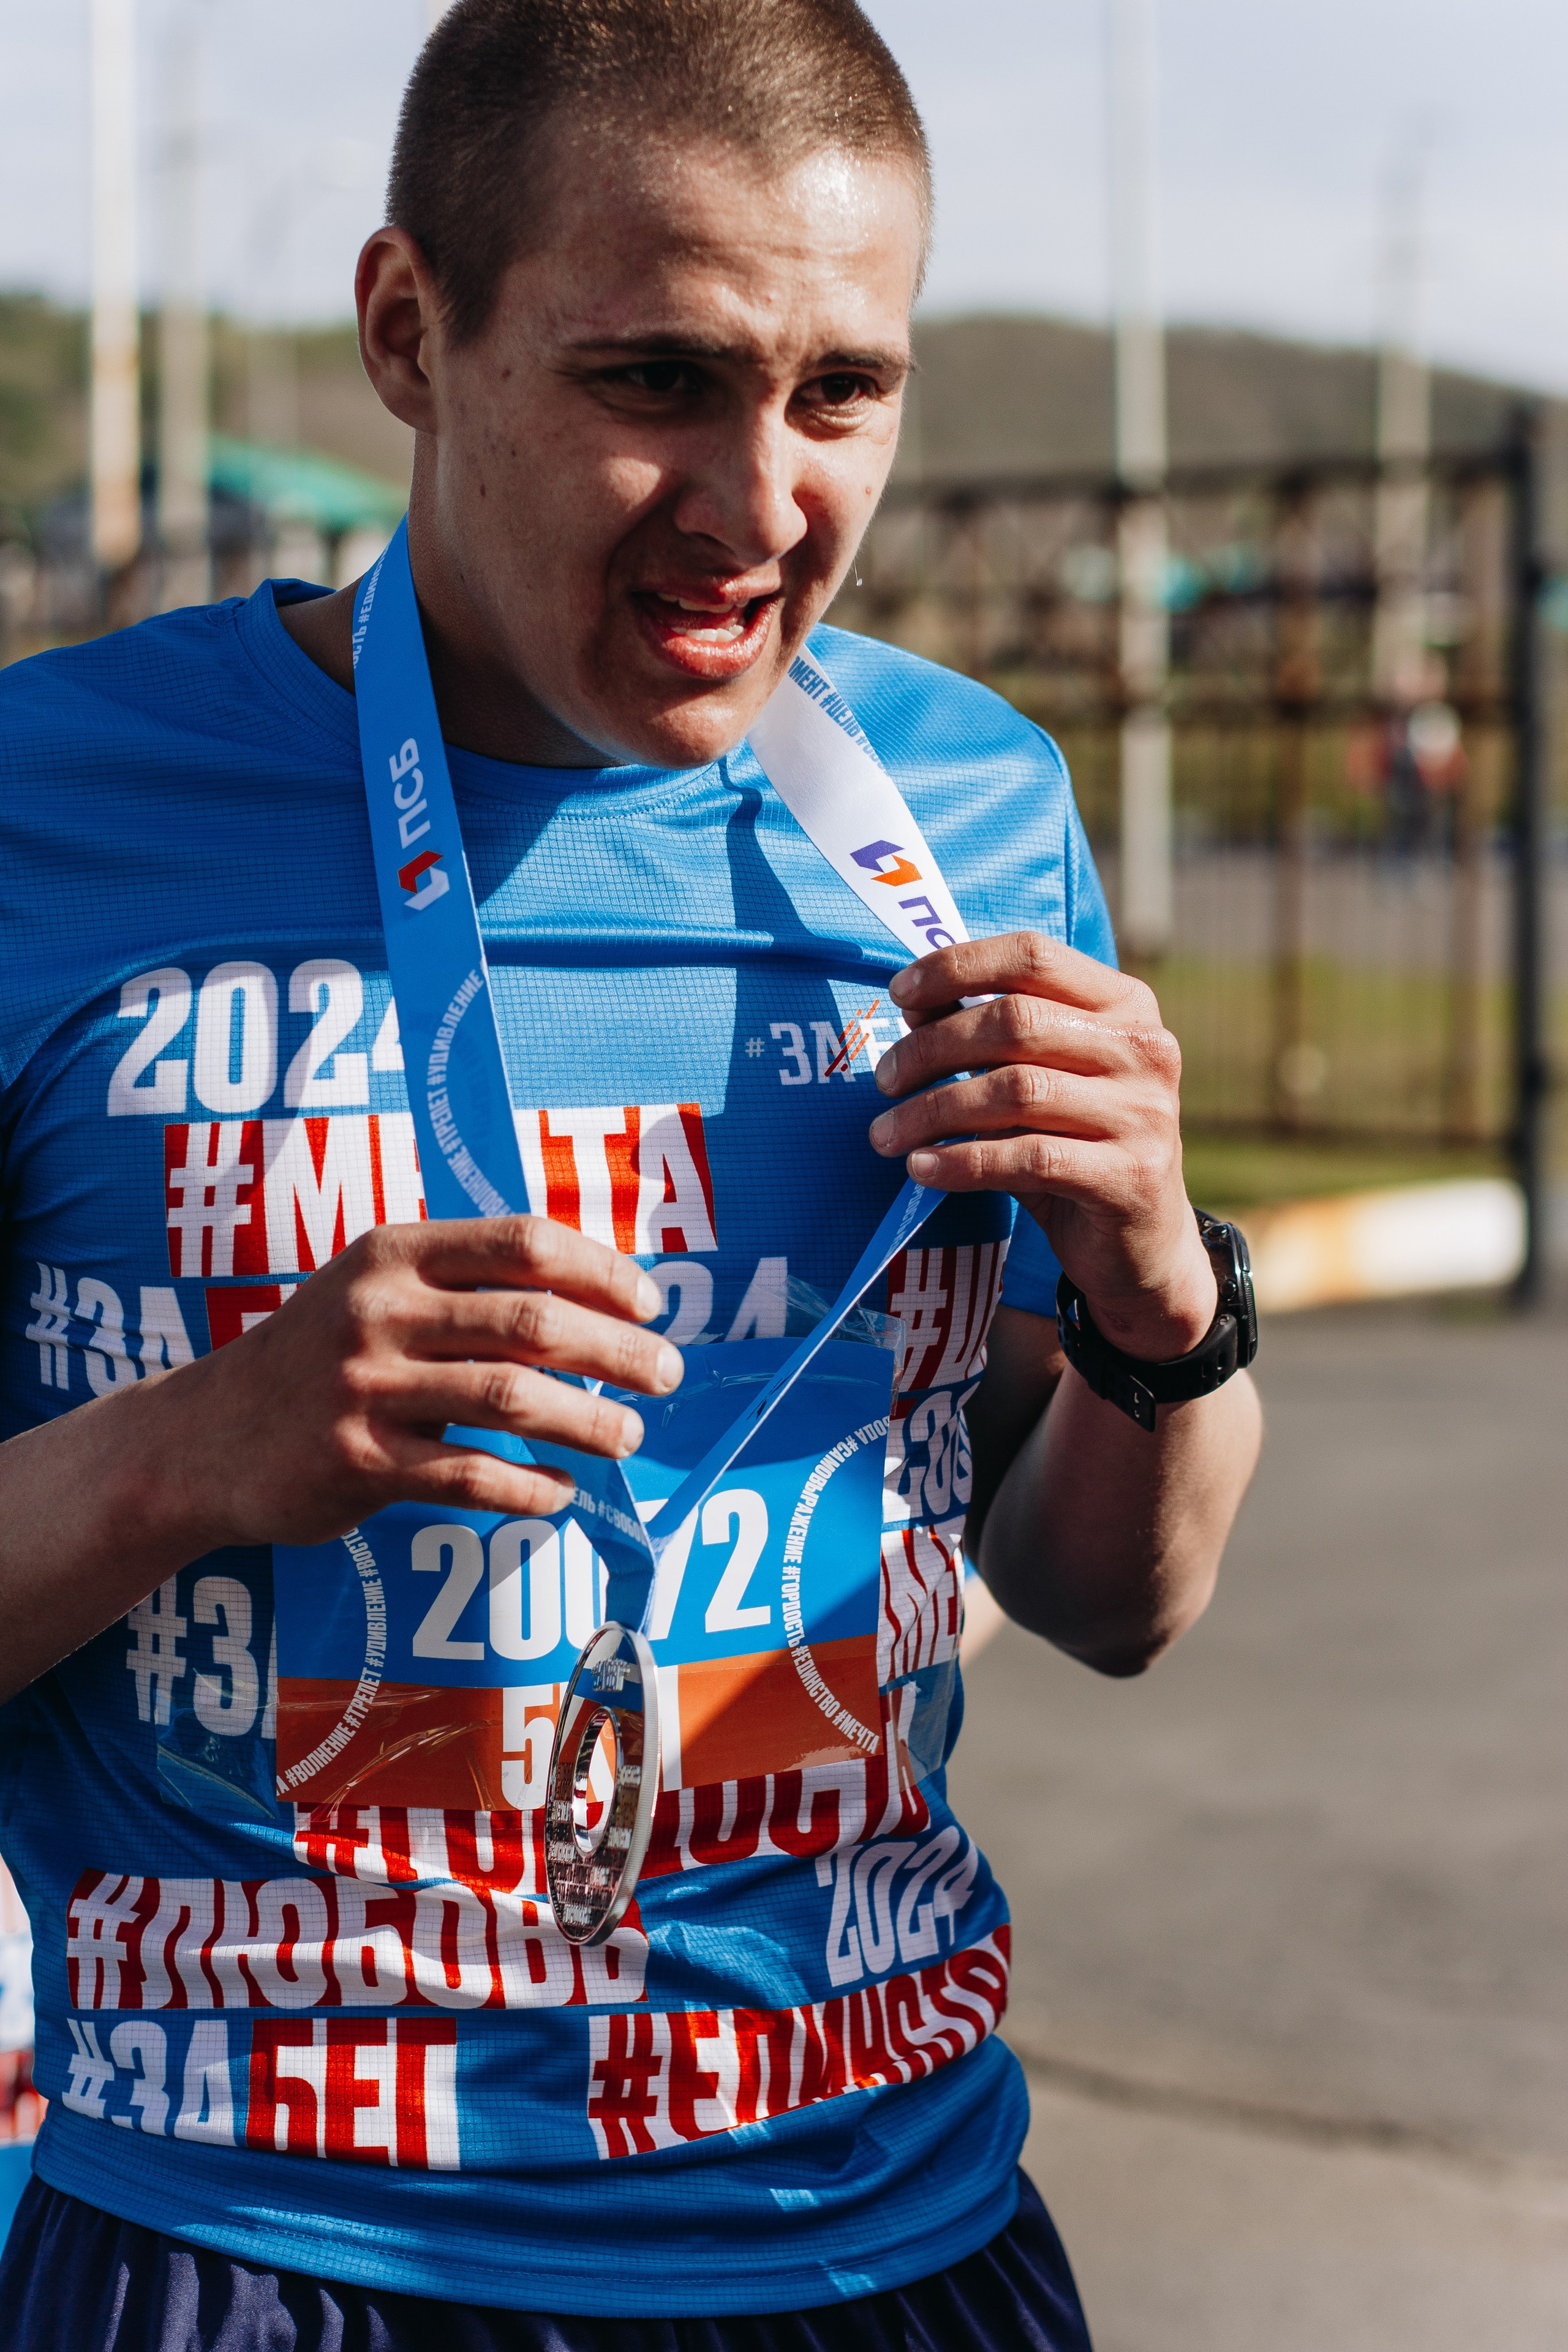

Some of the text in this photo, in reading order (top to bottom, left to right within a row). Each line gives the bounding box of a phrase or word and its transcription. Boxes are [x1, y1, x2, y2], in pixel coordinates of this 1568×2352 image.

[389, 737, 431, 849] ПСБ
[897, 895, 957, 951] ПС
[427, 969, 484, 1085] #УДИВЛЕНИЕ
[654, 1256, 788, 1346] 24
[573, 1487, 596, 1514] ЕЛЬ
[783, 1435, 859, 1564] #САМОВЫРАЖЕНИЕ
[341, 1526, 379, 1578] #ВОСТО
[361, 1578, 387, 1668] #УДИВЛЕНИЕ
[780, 1565, 805, 1648] #ГОРДОСТЬ
[342, 1667, 382, 1728] #ТРЕПЕТ
[791, 1645, 841, 1719] #ЕДИНСТВО
[284, 1722, 356, 1788] #ВОЛНЕНИЕ
[831, 1709, 880, 1755] #МЕЧТА
[67, 1871, 650, 2010] #ЛЮБОВЬ
[815, 1825, 979, 1988] 2024
[61, 2017, 458, 2171] #ЗАБЕГ
